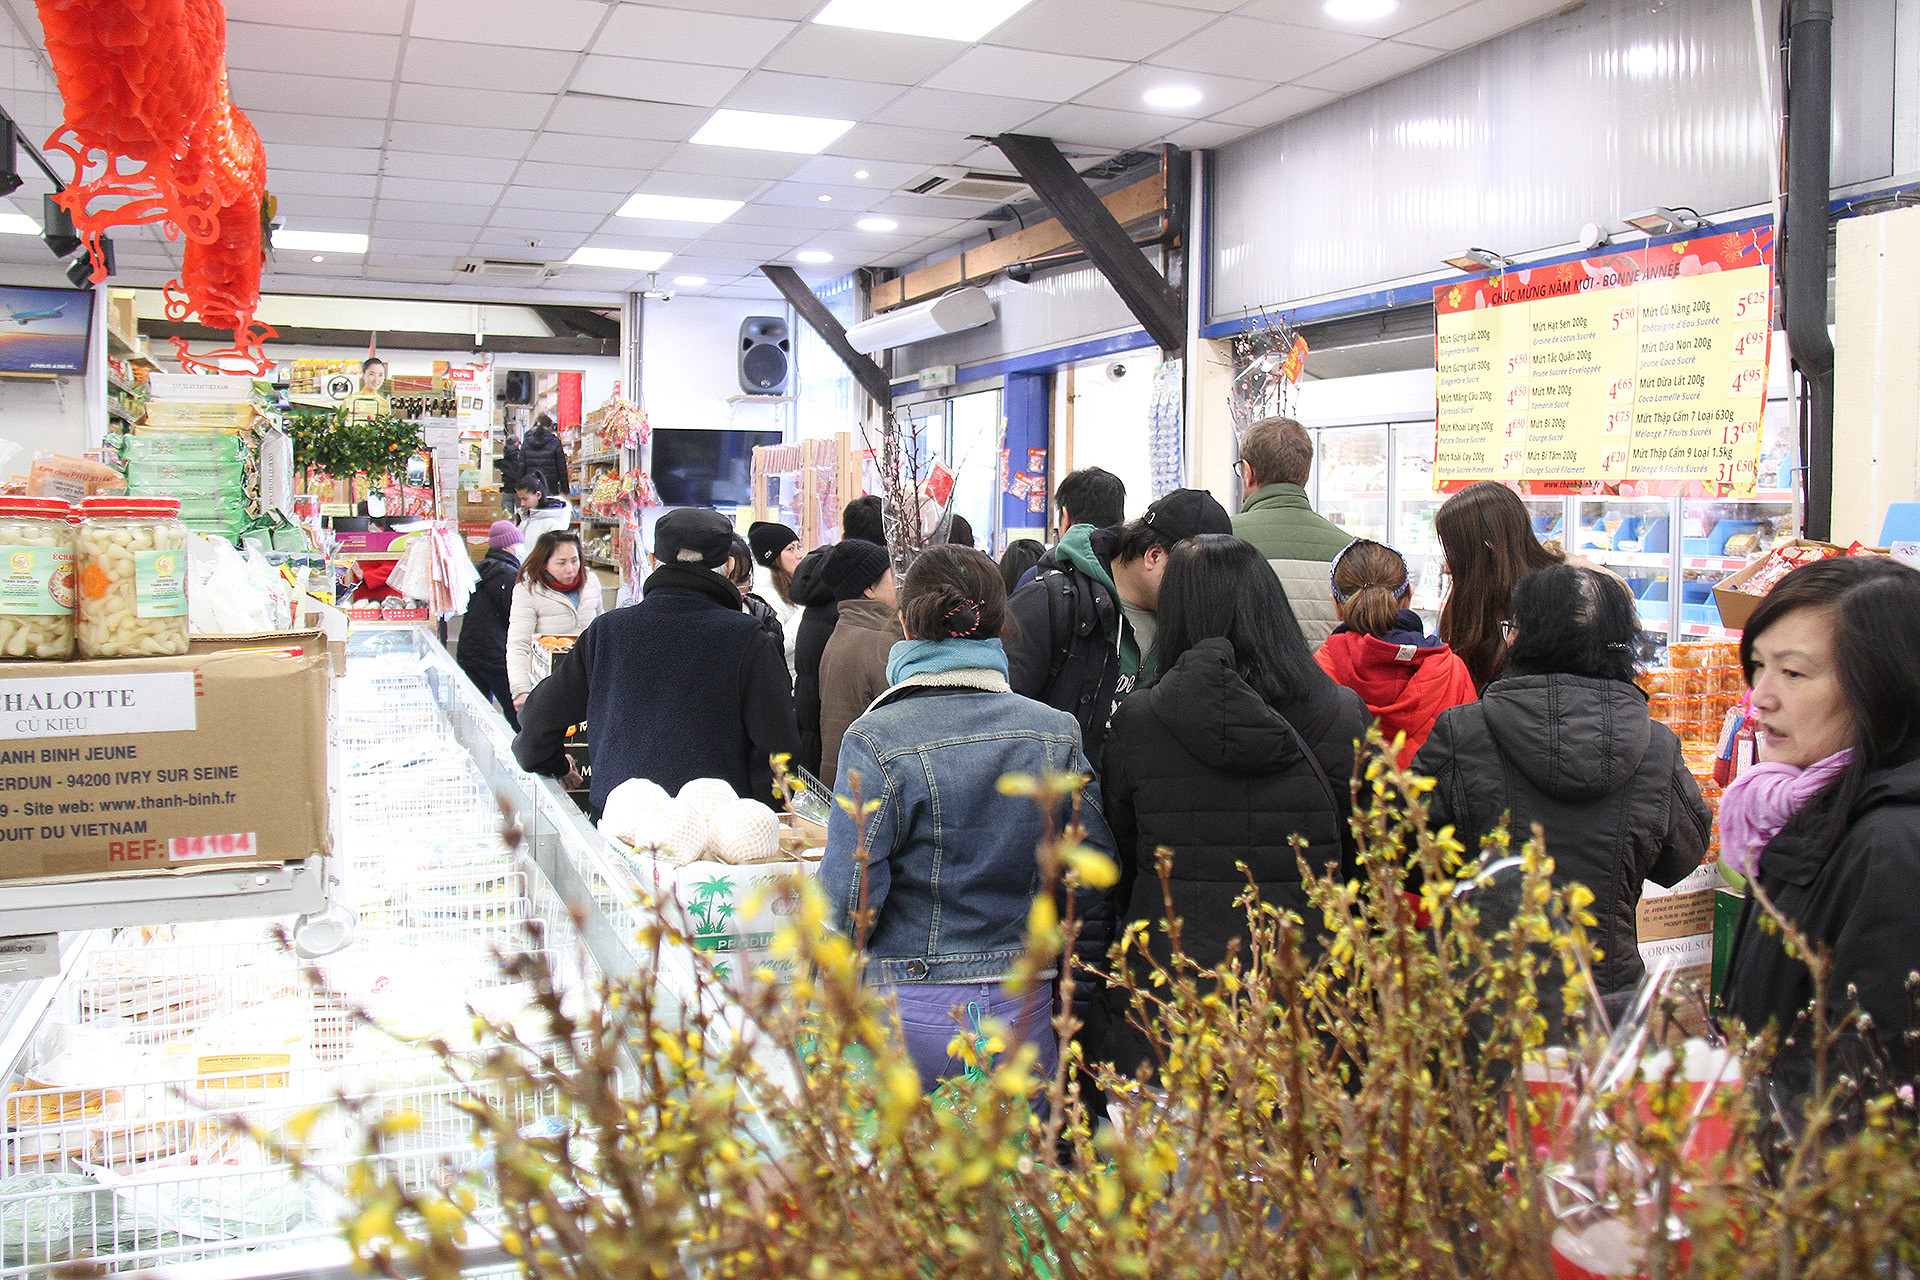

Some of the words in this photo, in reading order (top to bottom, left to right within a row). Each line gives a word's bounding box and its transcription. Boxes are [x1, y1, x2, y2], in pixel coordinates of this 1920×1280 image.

[1549, 278, 1571, 295] NĂM
[1602, 268, 1640, 287] BONNE
[1642, 260, 1681, 280] ANNÉE
[1692, 300, 1711, 313] 200g
[1736, 291, 1765, 317] 5€25
[1560, 319, 1571, 330] Sen
[1572, 317, 1588, 329] 200g
[1676, 339, 1692, 351] Non
[1693, 337, 1712, 351] 200g
[1735, 332, 1764, 356] 4€95
[1577, 350, 1592, 362] 200g
[1558, 385, 1572, 397] 200g
[1687, 374, 1705, 388] 200g
[1732, 369, 1761, 393] 4€95
[1551, 418, 1566, 430] 200g
[1691, 411, 1696, 421] 7
[1715, 409, 1734, 423] 630g
[1721, 421, 1758, 445] 13€50
[1562, 450, 1577, 462] 200g
[1687, 447, 1692, 458] 9
[1712, 446, 1733, 460] 1.5kg
[1715, 459, 1753, 482] 31€50
[45, 714, 88, 735] KIỆU
[0, 749, 35, 765] ANH
[40, 747, 81, 763] BINH
[84, 745, 138, 762] JEUNE
[66, 772, 110, 788] 94200
[114, 770, 152, 785] IVRY
[155, 768, 189, 784] SUR
[192, 765, 239, 781] SEINE
[23, 800, 54, 816] Site
[58, 799, 95, 815] web:
[98, 792, 237, 812] www.thanh-binh.fr
[40, 825, 66, 840] DU
[70, 820, 148, 838] VIETNAM
[108, 838, 165, 862] REF:
